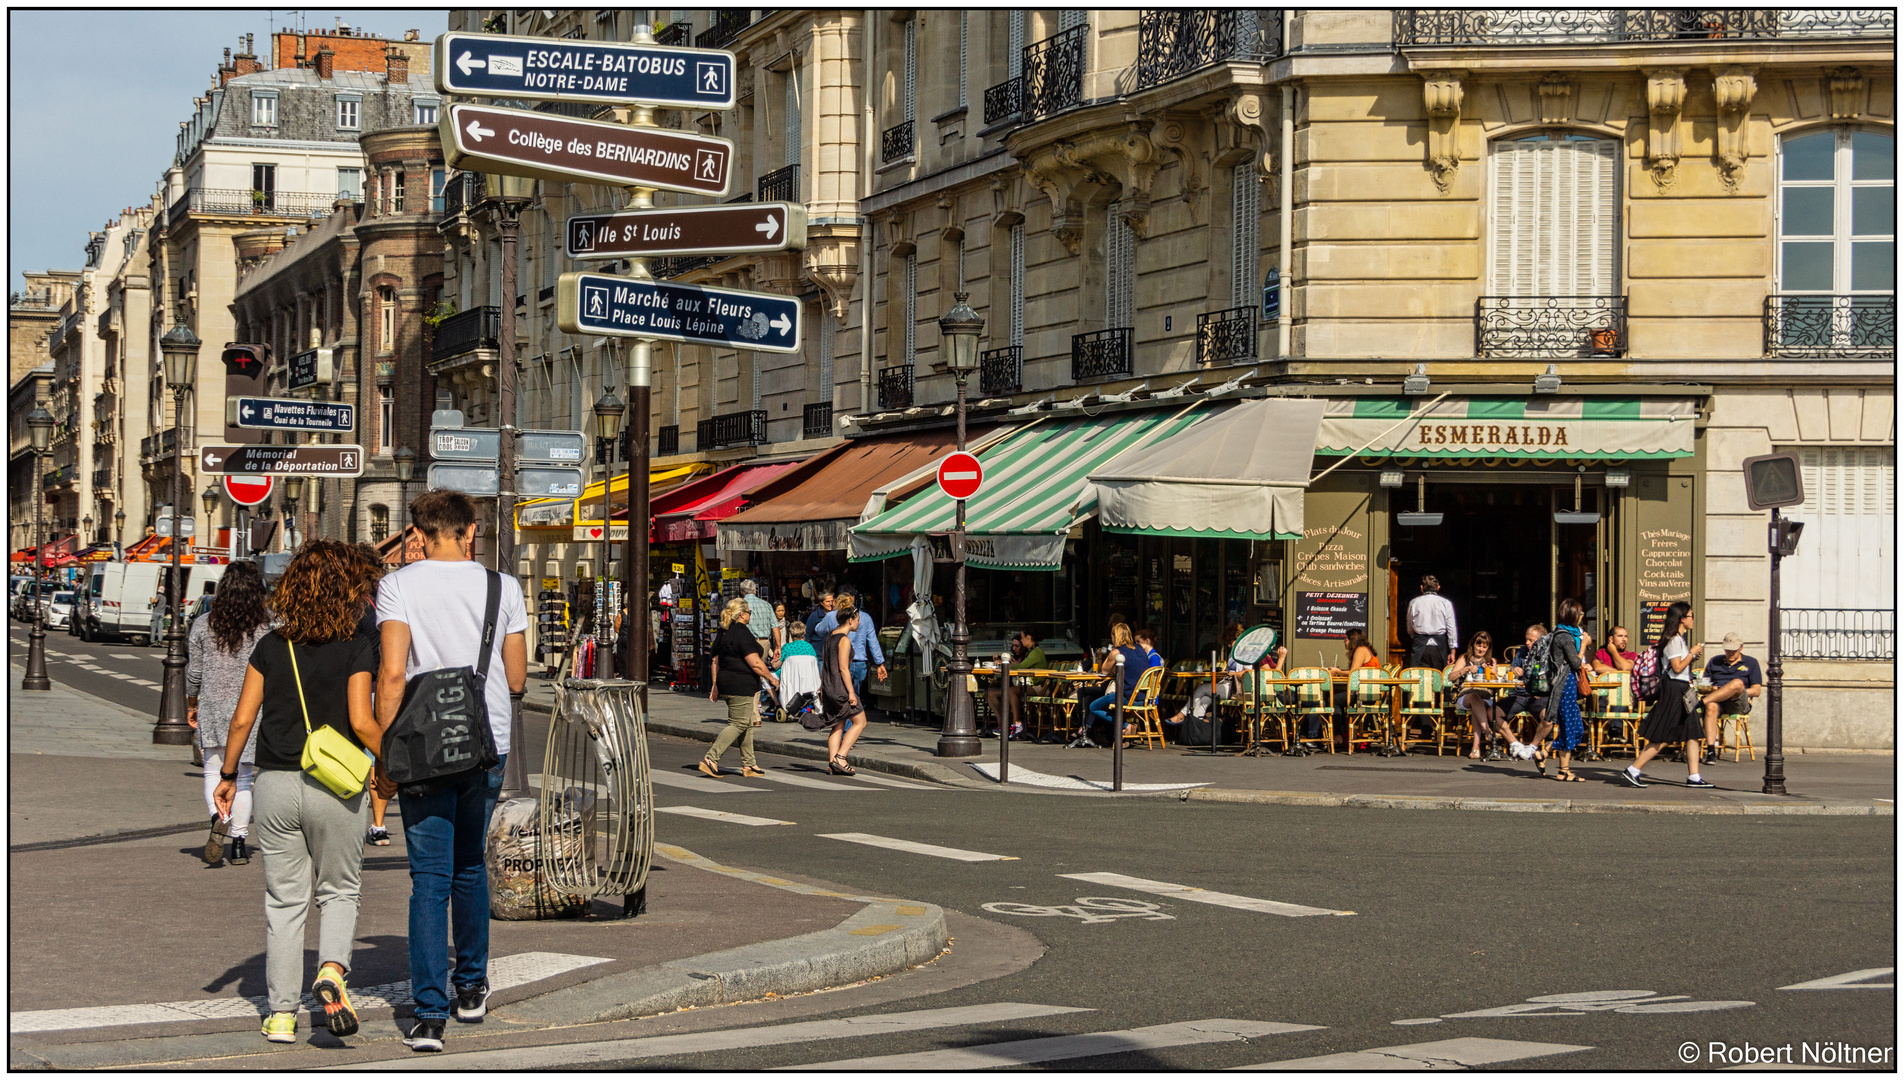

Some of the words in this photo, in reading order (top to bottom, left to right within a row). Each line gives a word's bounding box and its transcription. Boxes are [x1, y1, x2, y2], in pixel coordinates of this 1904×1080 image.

[526, 50, 686, 76] ESCALE-BATOBUS
[525, 72, 628, 92] NOTRE-DAME
[508, 128, 563, 154] Collège
[567, 137, 592, 156] des
[595, 140, 691, 171] BERNARDINS
[599, 226, 617, 243] Ile
[643, 223, 681, 242] Louis
[614, 286, 669, 310] Marché
[676, 297, 701, 313] aux
[707, 297, 751, 318] Fleurs
[612, 308, 645, 326] Place
[650, 312, 681, 330] Louis
[685, 315, 725, 335] Lépine
[274, 403, 305, 415] Navettes
[306, 405, 337, 416] Fluviales
[274, 415, 288, 424] Quai
[289, 416, 297, 425] de
[298, 417, 304, 425] la
[1419, 425, 1568, 446] ESMERALDA
[246, 449, 297, 459] Mémorial
[245, 461, 257, 471] de
[261, 461, 271, 471] la
[275, 461, 338, 473] Déportation
[1304, 527, 1327, 539] Plats
[1329, 525, 1340, 534] du
[1341, 526, 1362, 539] Jour
[1660, 528, 1691, 541] Mariage
[1319, 542, 1344, 551] Pizza
[1651, 539, 1678, 548] Frères
[1297, 551, 1330, 562] Crêpes
[1334, 551, 1367, 560] Maison
[1641, 548, 1691, 558] Cappuccino
[1296, 561, 1317, 571] Club
[1320, 561, 1365, 571] sandwiches
[1645, 558, 1683, 567] Chocolat
[1297, 572, 1322, 587] Glaces
[1323, 572, 1368, 588] Artisanales
[1644, 570, 1684, 578] Cocktails
[1639, 579, 1658, 587] Vins
[1669, 579, 1691, 588] Verre
[1639, 588, 1661, 600] Bières
[1662, 590, 1691, 601] Pression
